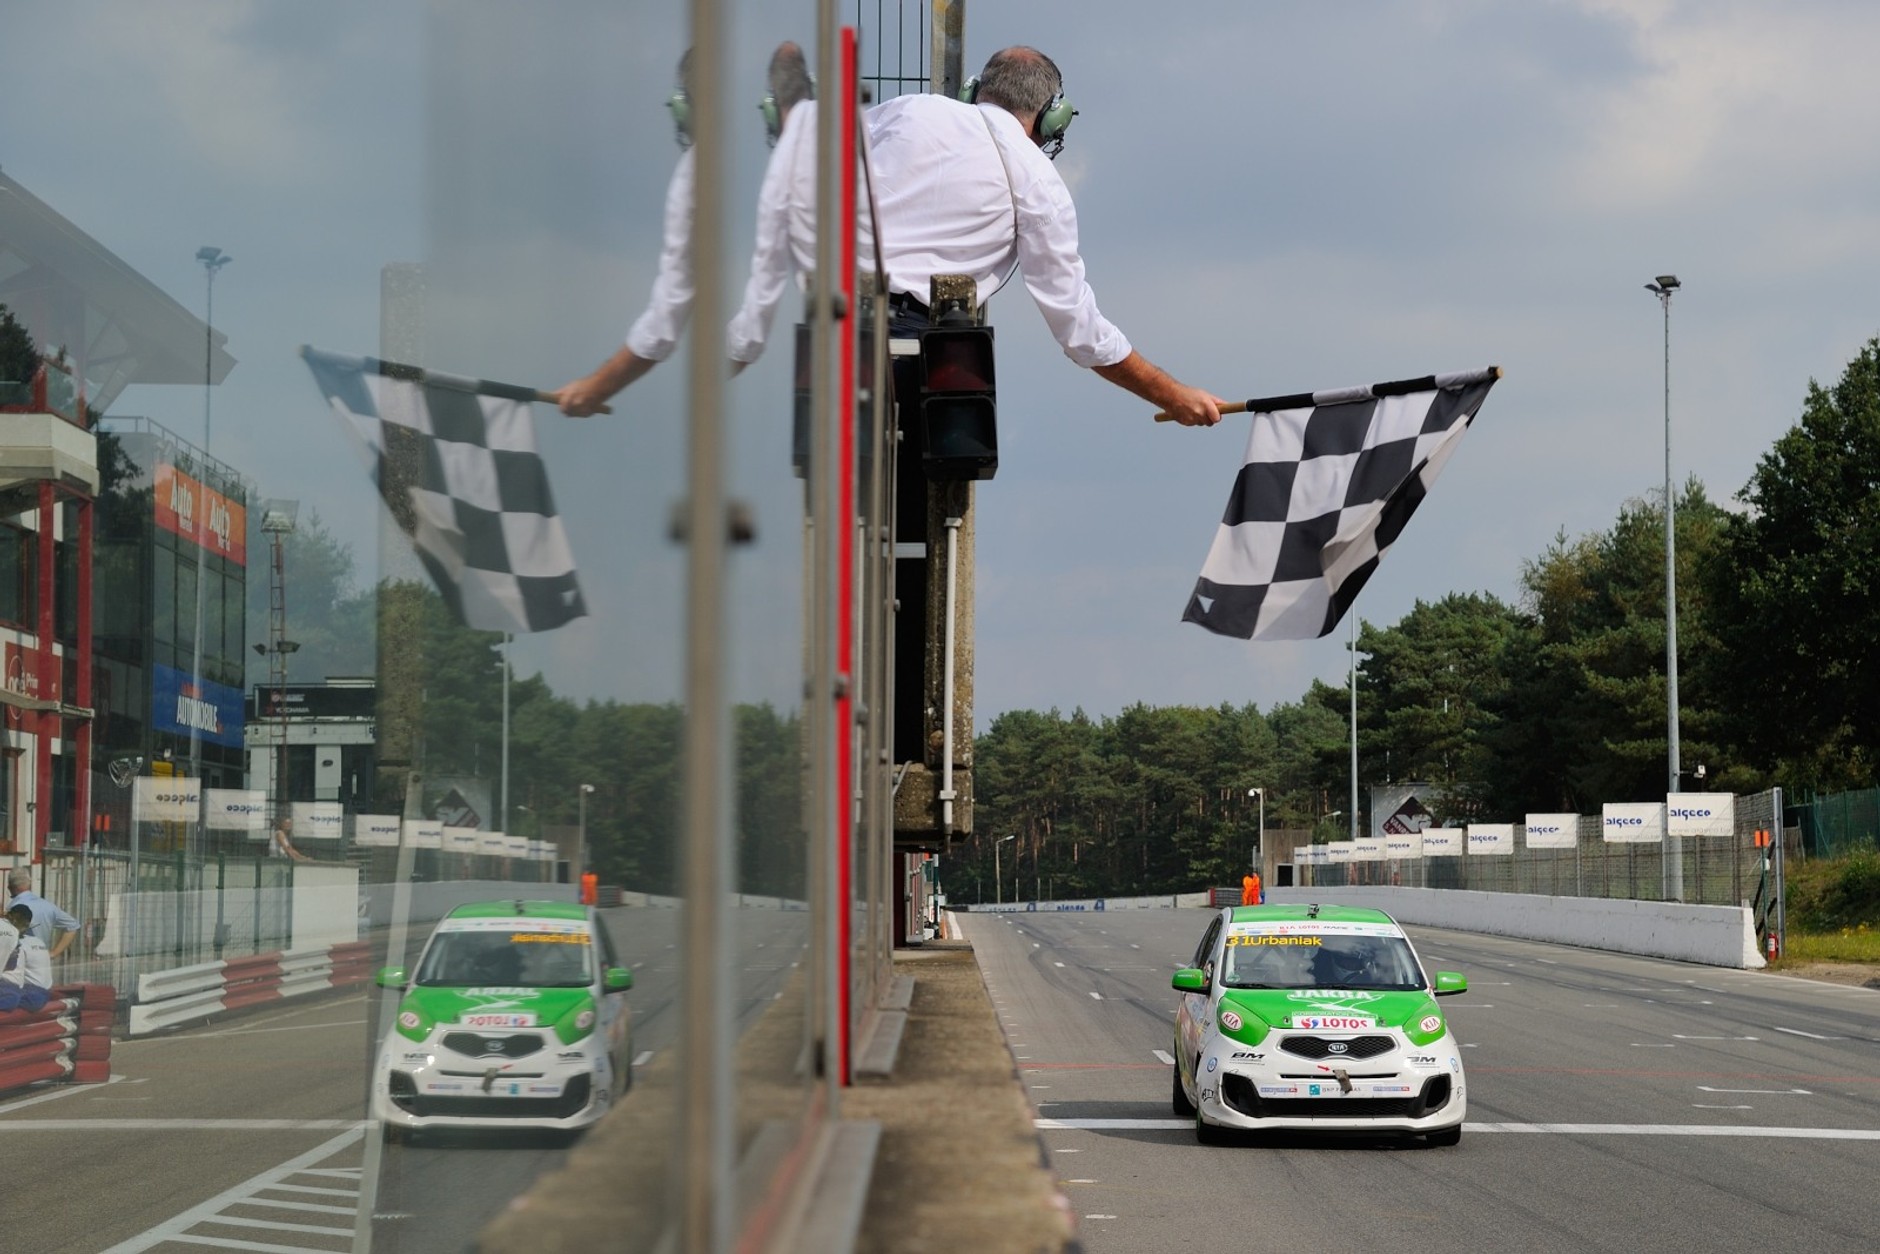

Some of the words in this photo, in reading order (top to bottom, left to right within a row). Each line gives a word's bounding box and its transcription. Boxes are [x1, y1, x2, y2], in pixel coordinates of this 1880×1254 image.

[170, 474, 193, 521] Auto
[209, 496, 231, 541] Auto
[176, 694, 218, 734] AUTOMOBILE
[1670, 808, 1711, 821] algeco
[1606, 817, 1643, 829] algeco
[1470, 834, 1498, 844] algeco
[1250, 935, 1323, 946] Urbaniak
[1223, 1013, 1239, 1029] KIA
[1322, 1017, 1368, 1029] LOTOS
[1423, 1017, 1440, 1030] KIA
